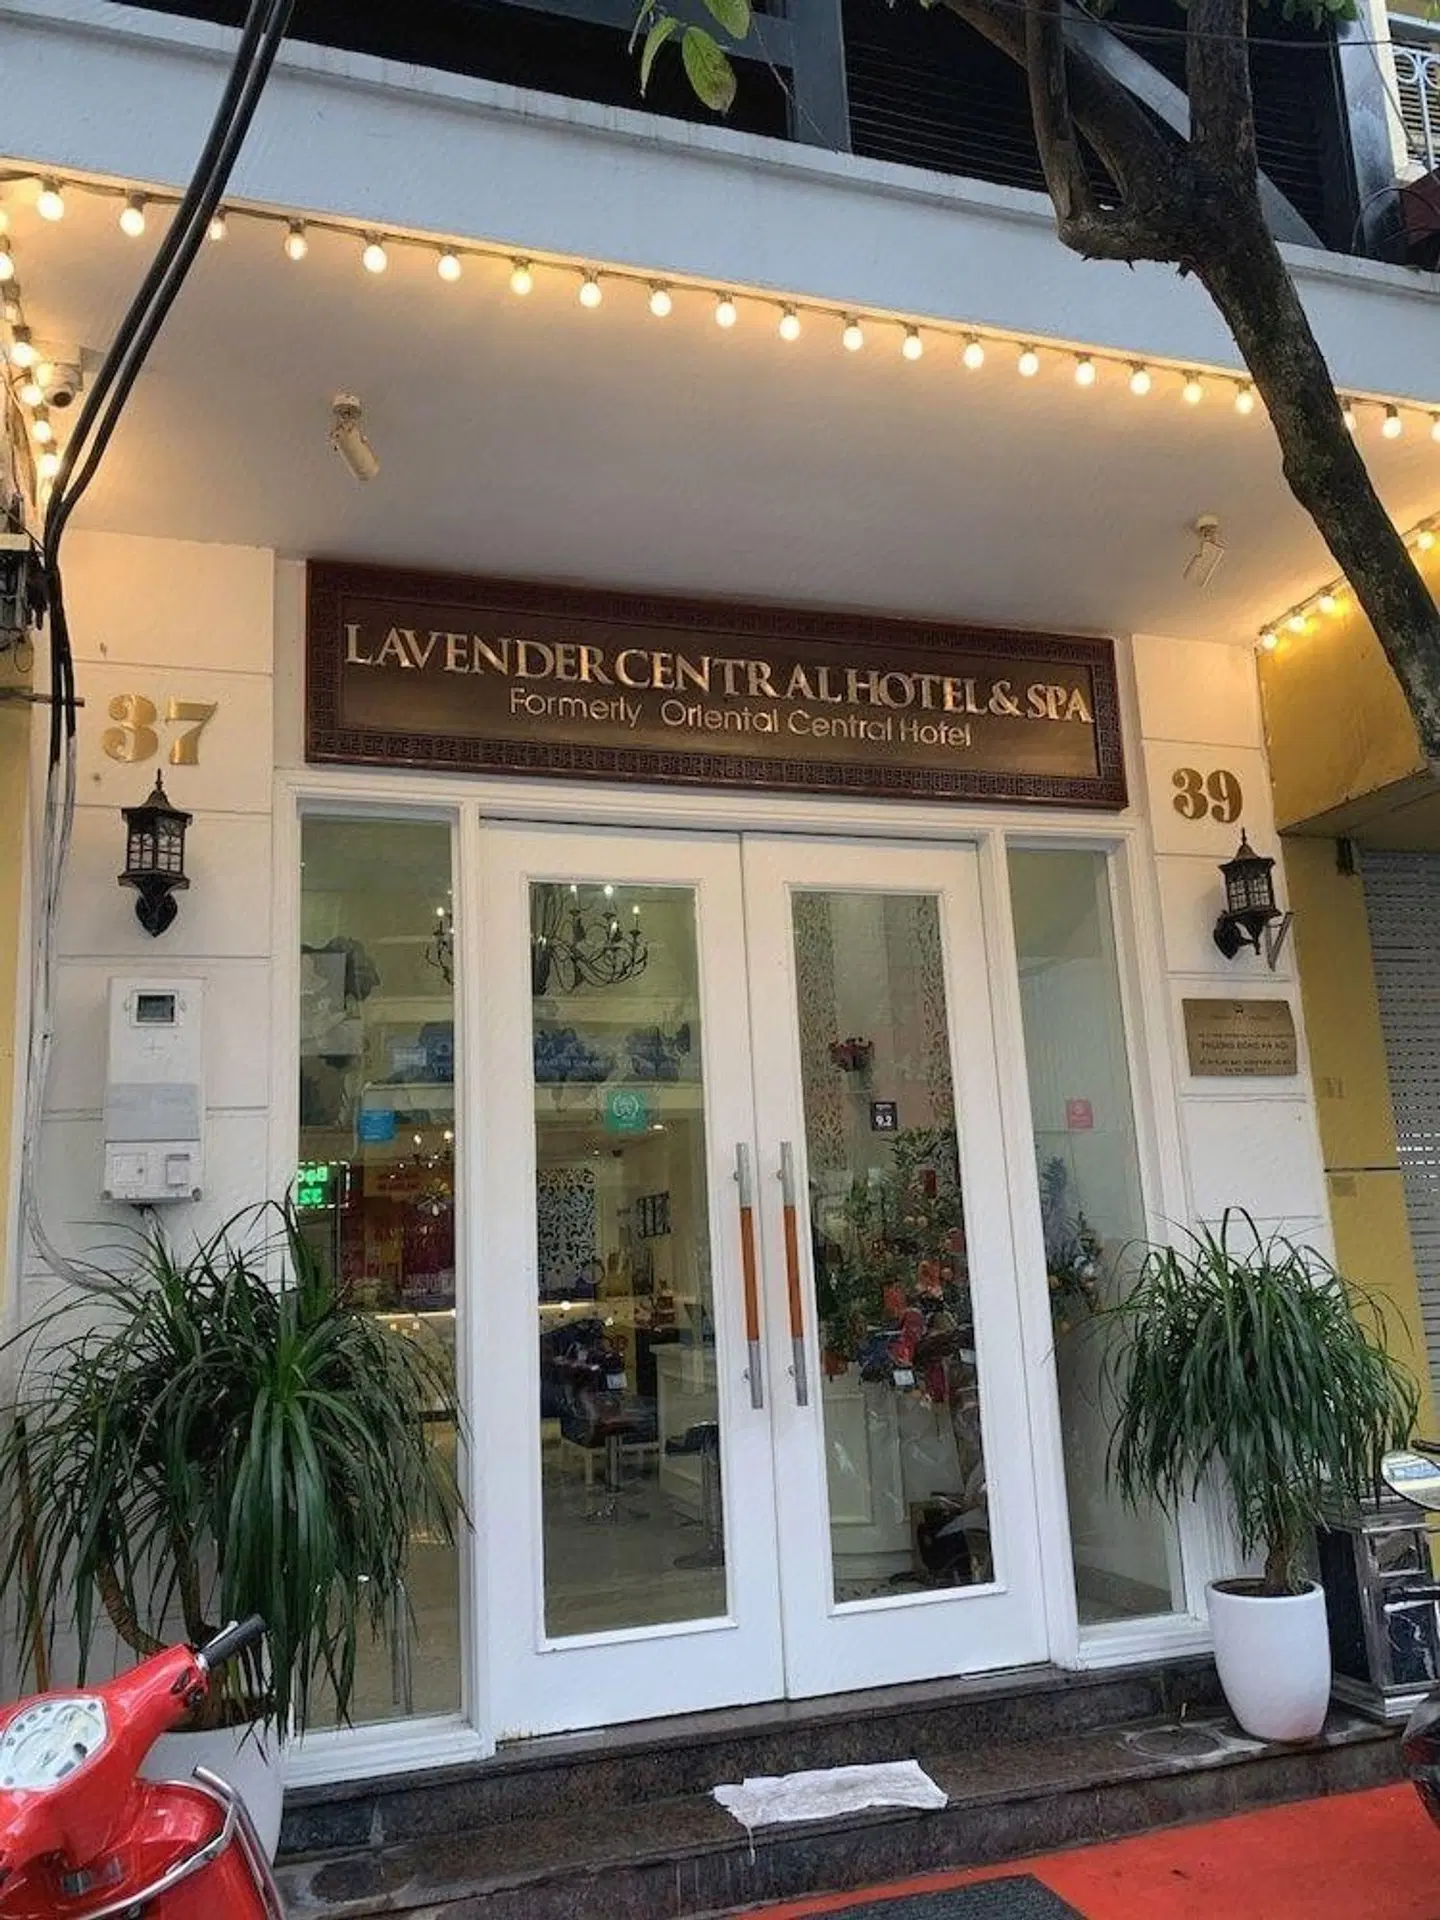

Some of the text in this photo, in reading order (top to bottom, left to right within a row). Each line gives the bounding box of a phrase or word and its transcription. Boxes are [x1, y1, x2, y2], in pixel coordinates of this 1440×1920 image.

[344, 623, 1094, 724] LAVENDER CENTRAL HOTEL & SPA
[102, 692, 219, 766] 37
[509, 687, 972, 748] Formerly Oriental Central Hotel
[1172, 767, 1243, 824] 39
